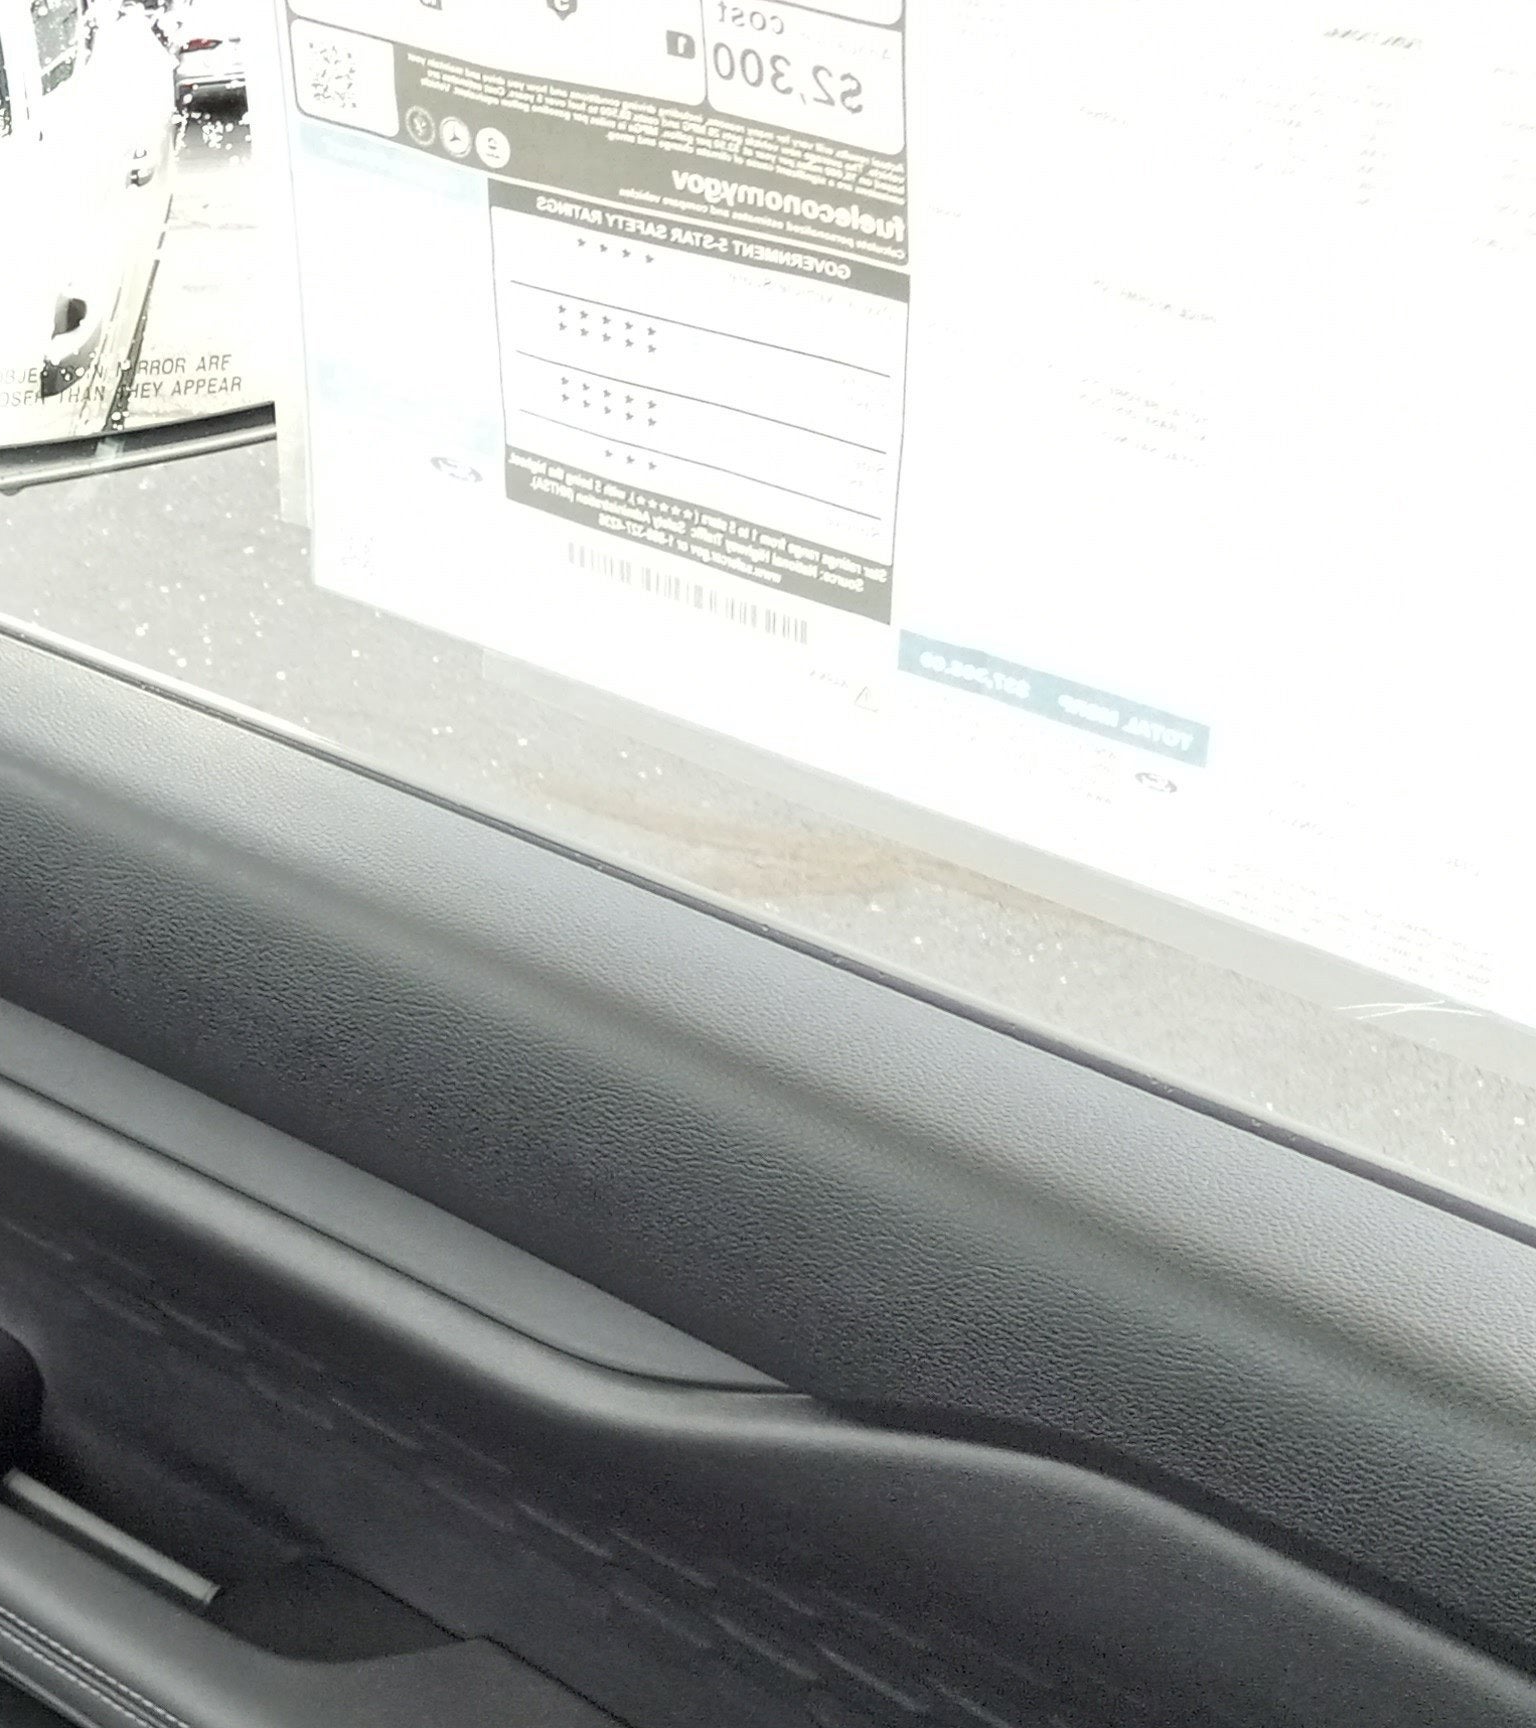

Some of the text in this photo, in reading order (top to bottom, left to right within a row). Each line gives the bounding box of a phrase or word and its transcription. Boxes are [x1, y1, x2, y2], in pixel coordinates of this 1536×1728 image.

[116, 359, 186, 378] MRROR
[58, 385, 106, 404] THAN
[122, 381, 161, 399] HEY
[172, 376, 242, 396] APPEAR
